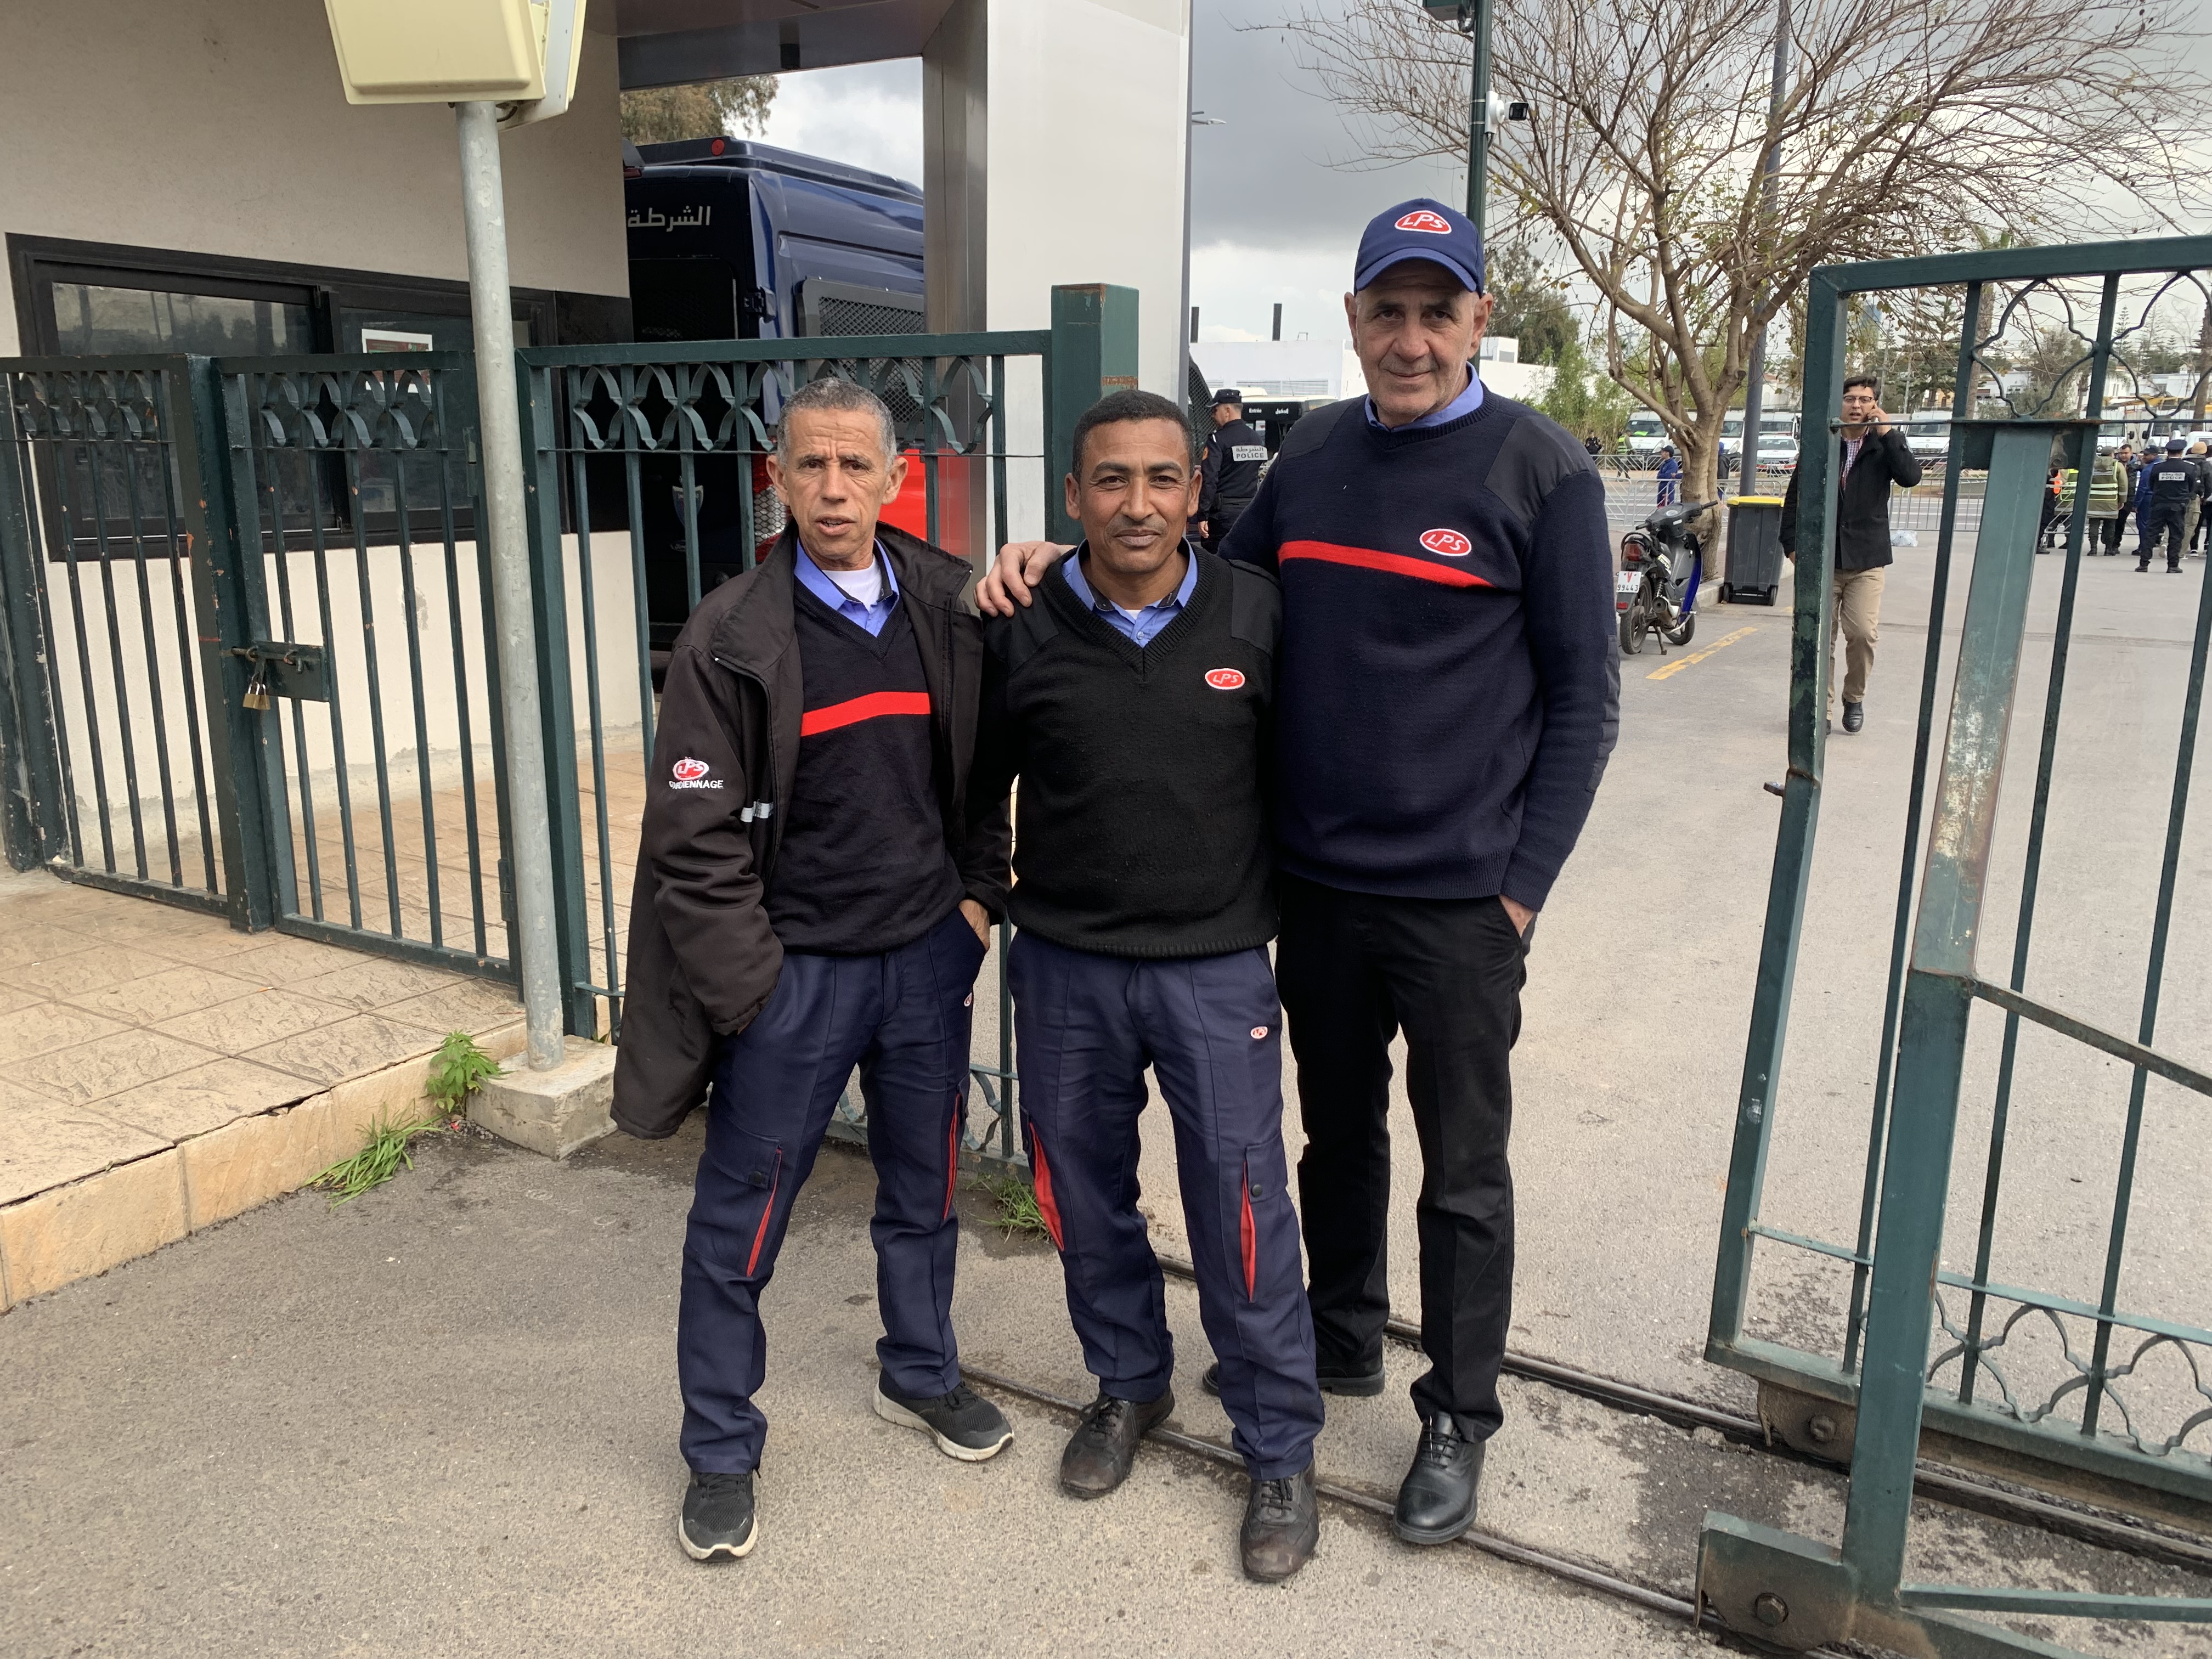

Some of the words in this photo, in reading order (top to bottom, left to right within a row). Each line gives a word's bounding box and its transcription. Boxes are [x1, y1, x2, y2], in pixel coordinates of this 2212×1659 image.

[628, 205, 711, 232] الشرطة
[1401, 214, 1446, 228] LPS
[1425, 534, 1465, 551] LPS
[1212, 673, 1239, 685] LPS
[677, 760, 704, 774] LPS
